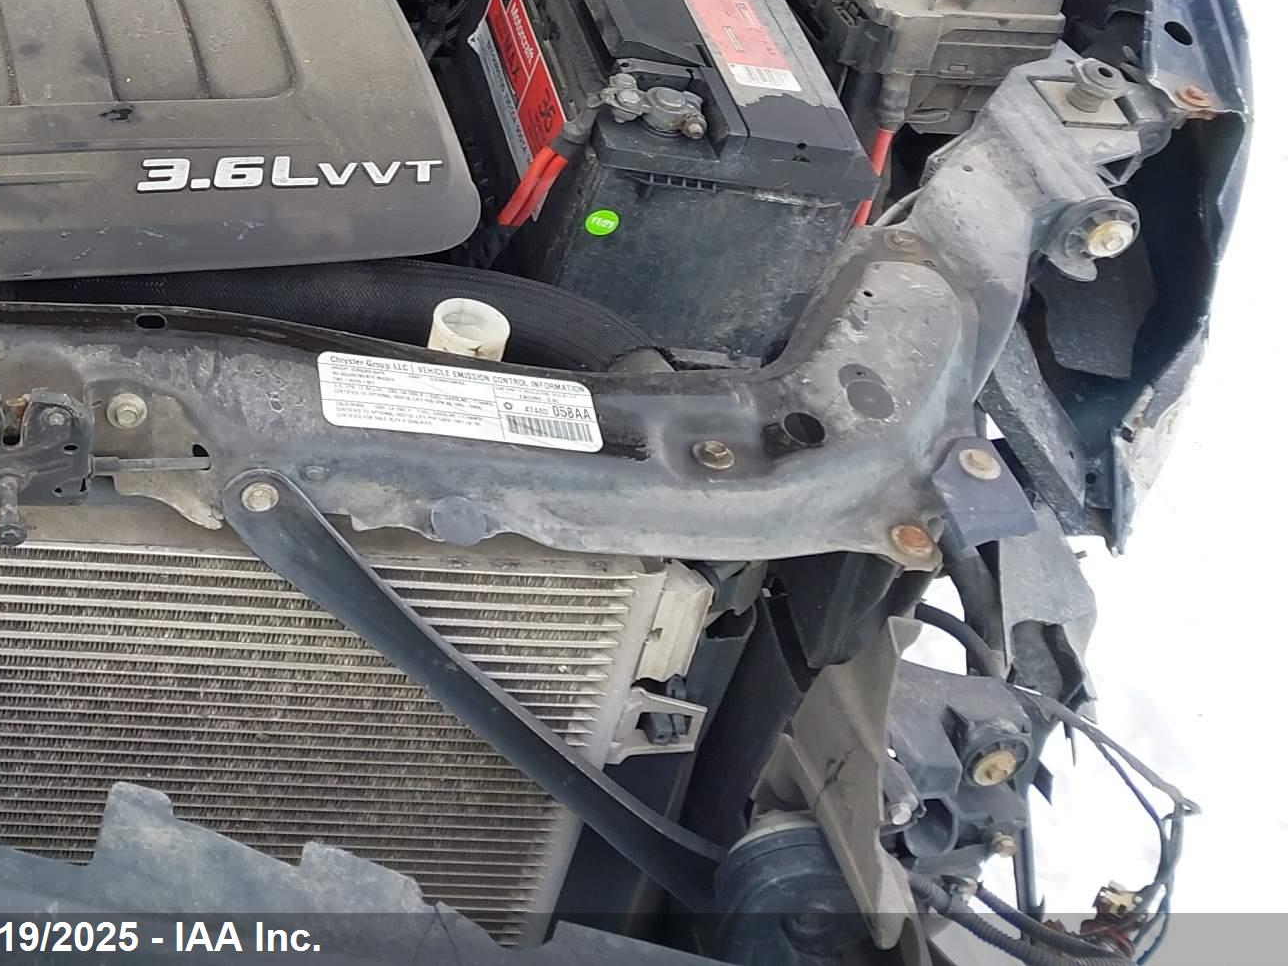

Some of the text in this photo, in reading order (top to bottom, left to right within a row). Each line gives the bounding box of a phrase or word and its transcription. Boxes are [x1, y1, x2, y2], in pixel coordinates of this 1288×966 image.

[510, 2, 535, 64] Motorcraft
[330, 356, 364, 366] Chrysler
[365, 360, 391, 370] Group
[392, 363, 409, 372] LLC
[417, 366, 451, 377] VEHICLE
[452, 370, 491, 383] EMISSION
[492, 376, 529, 387] CONTROL
[530, 381, 586, 394] INFORMATION
[551, 405, 592, 421] 058AA
